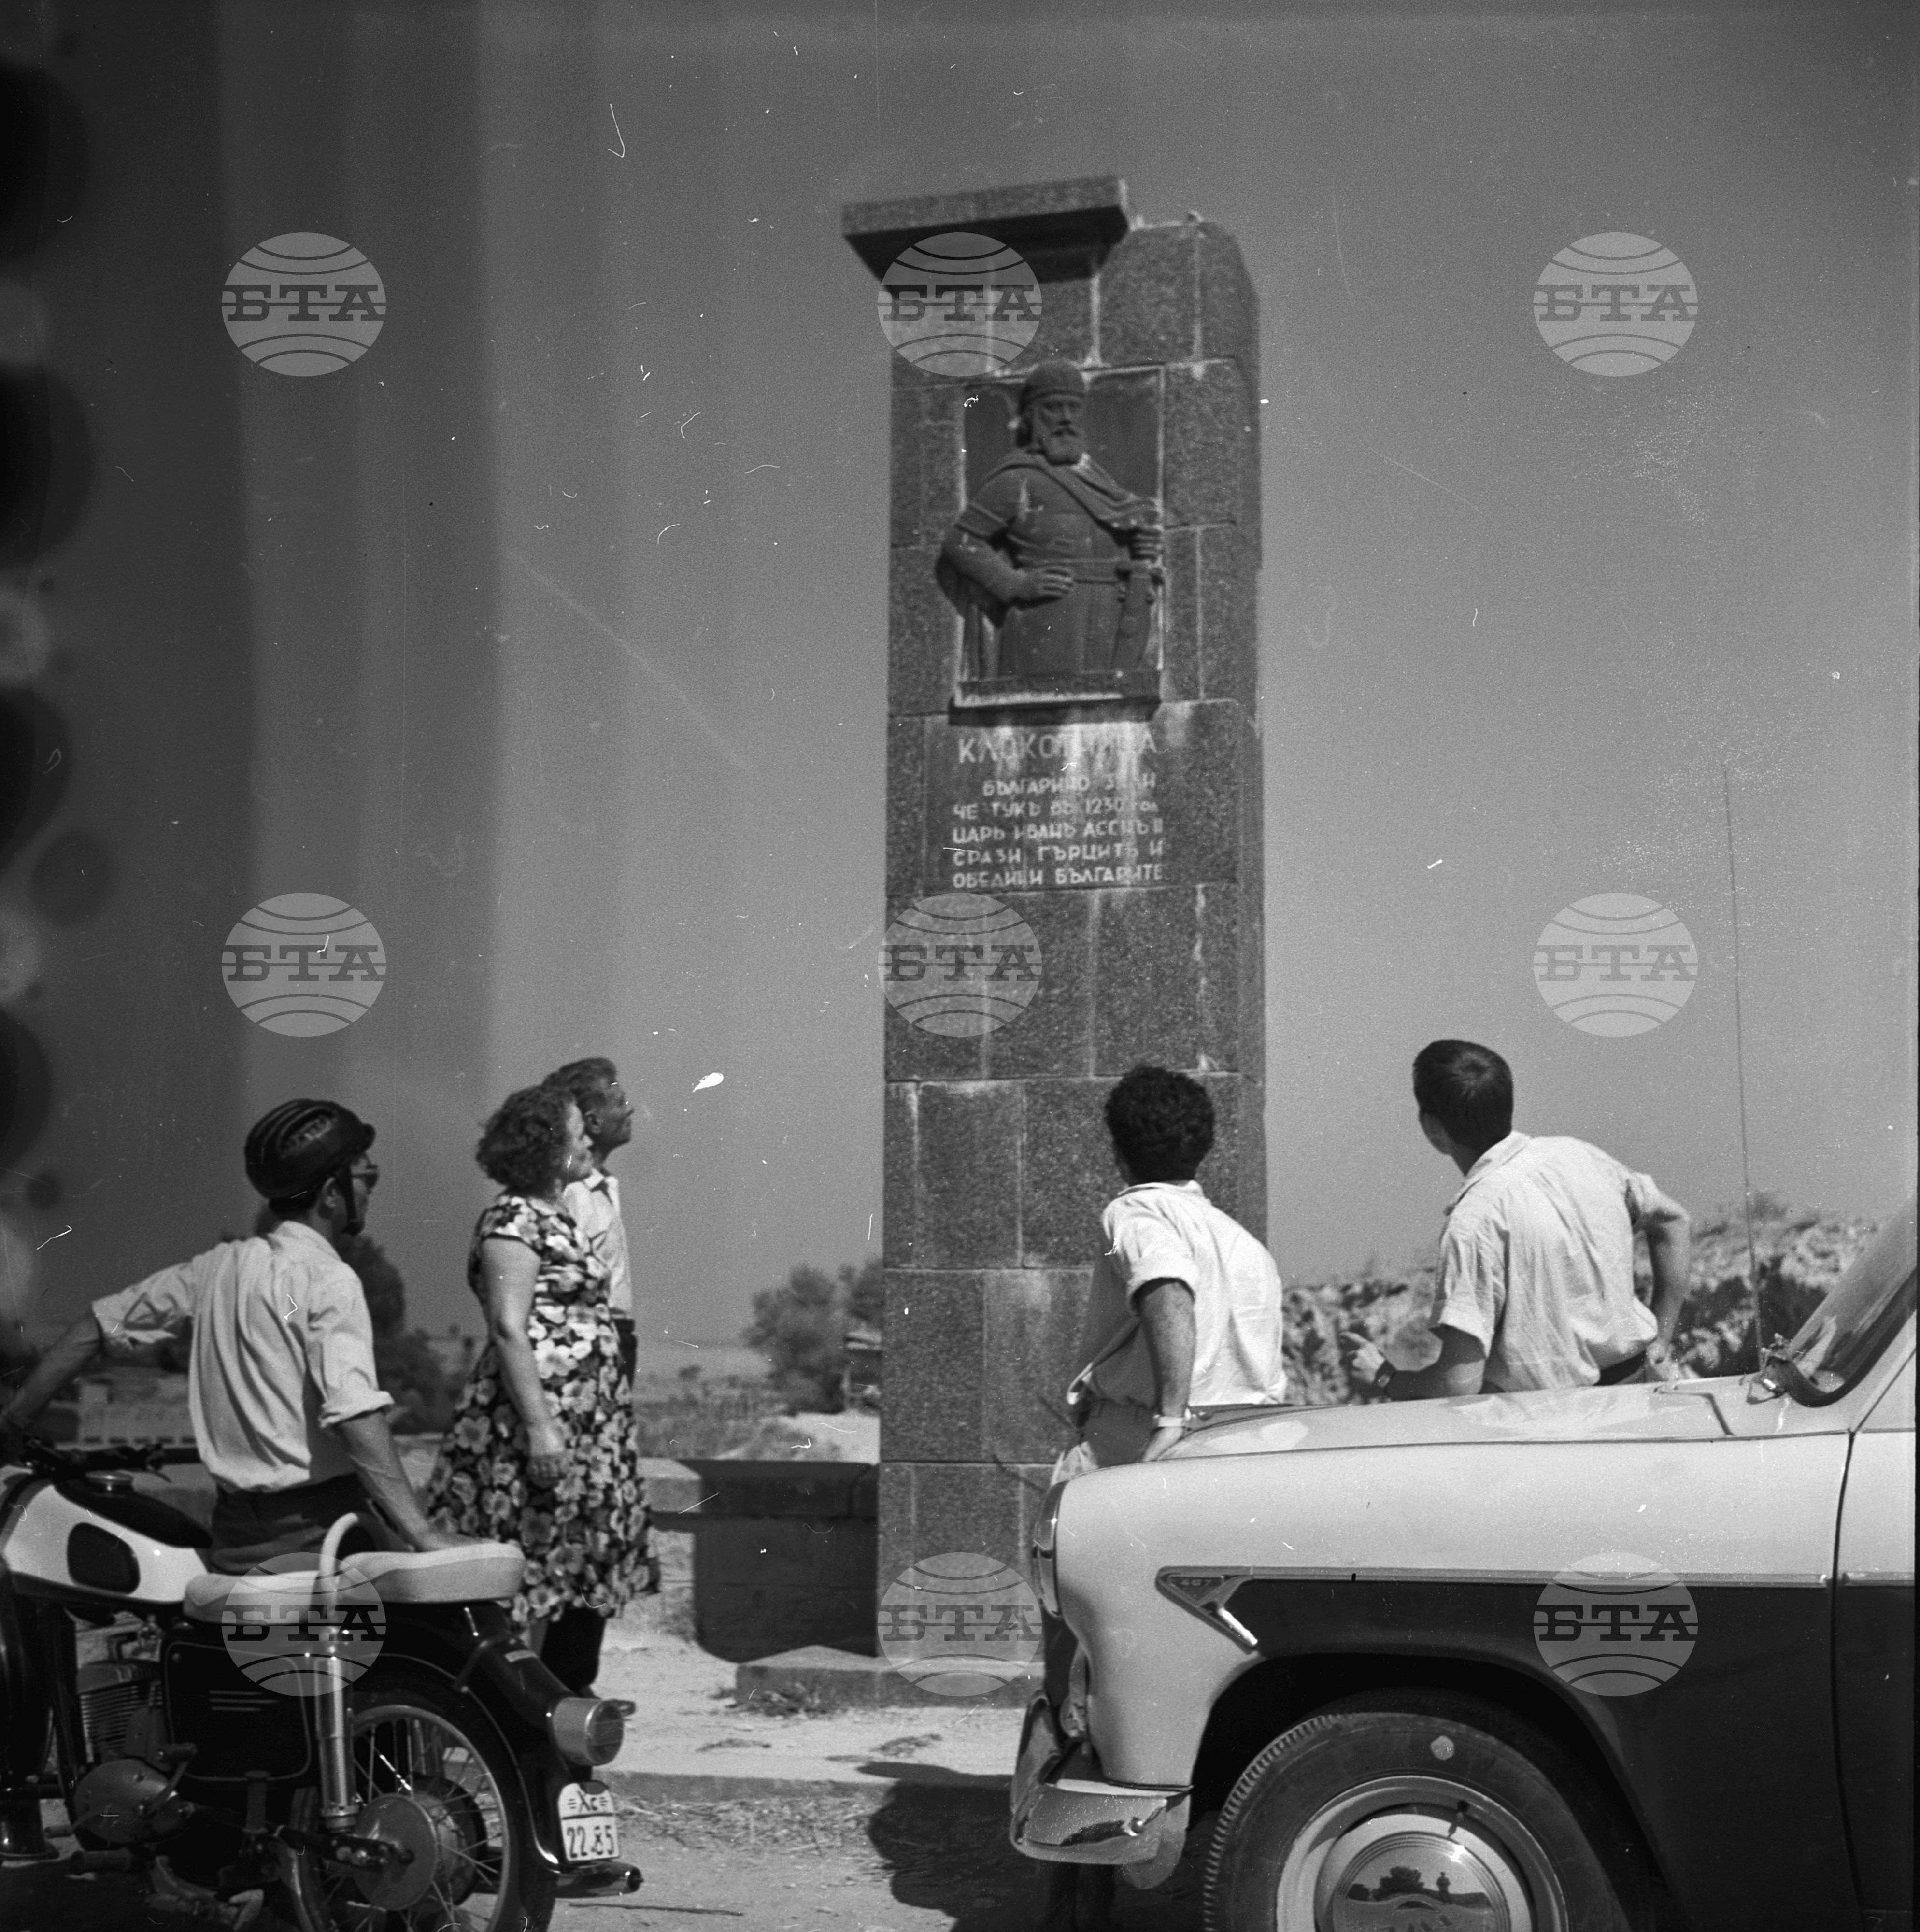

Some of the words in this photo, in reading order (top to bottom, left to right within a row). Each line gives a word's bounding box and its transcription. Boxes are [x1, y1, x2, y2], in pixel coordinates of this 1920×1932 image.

[953, 803, 979, 820] ЧЕ
[1086, 798, 1124, 814] 1230
[953, 848, 1021, 866] СРАЗИ
